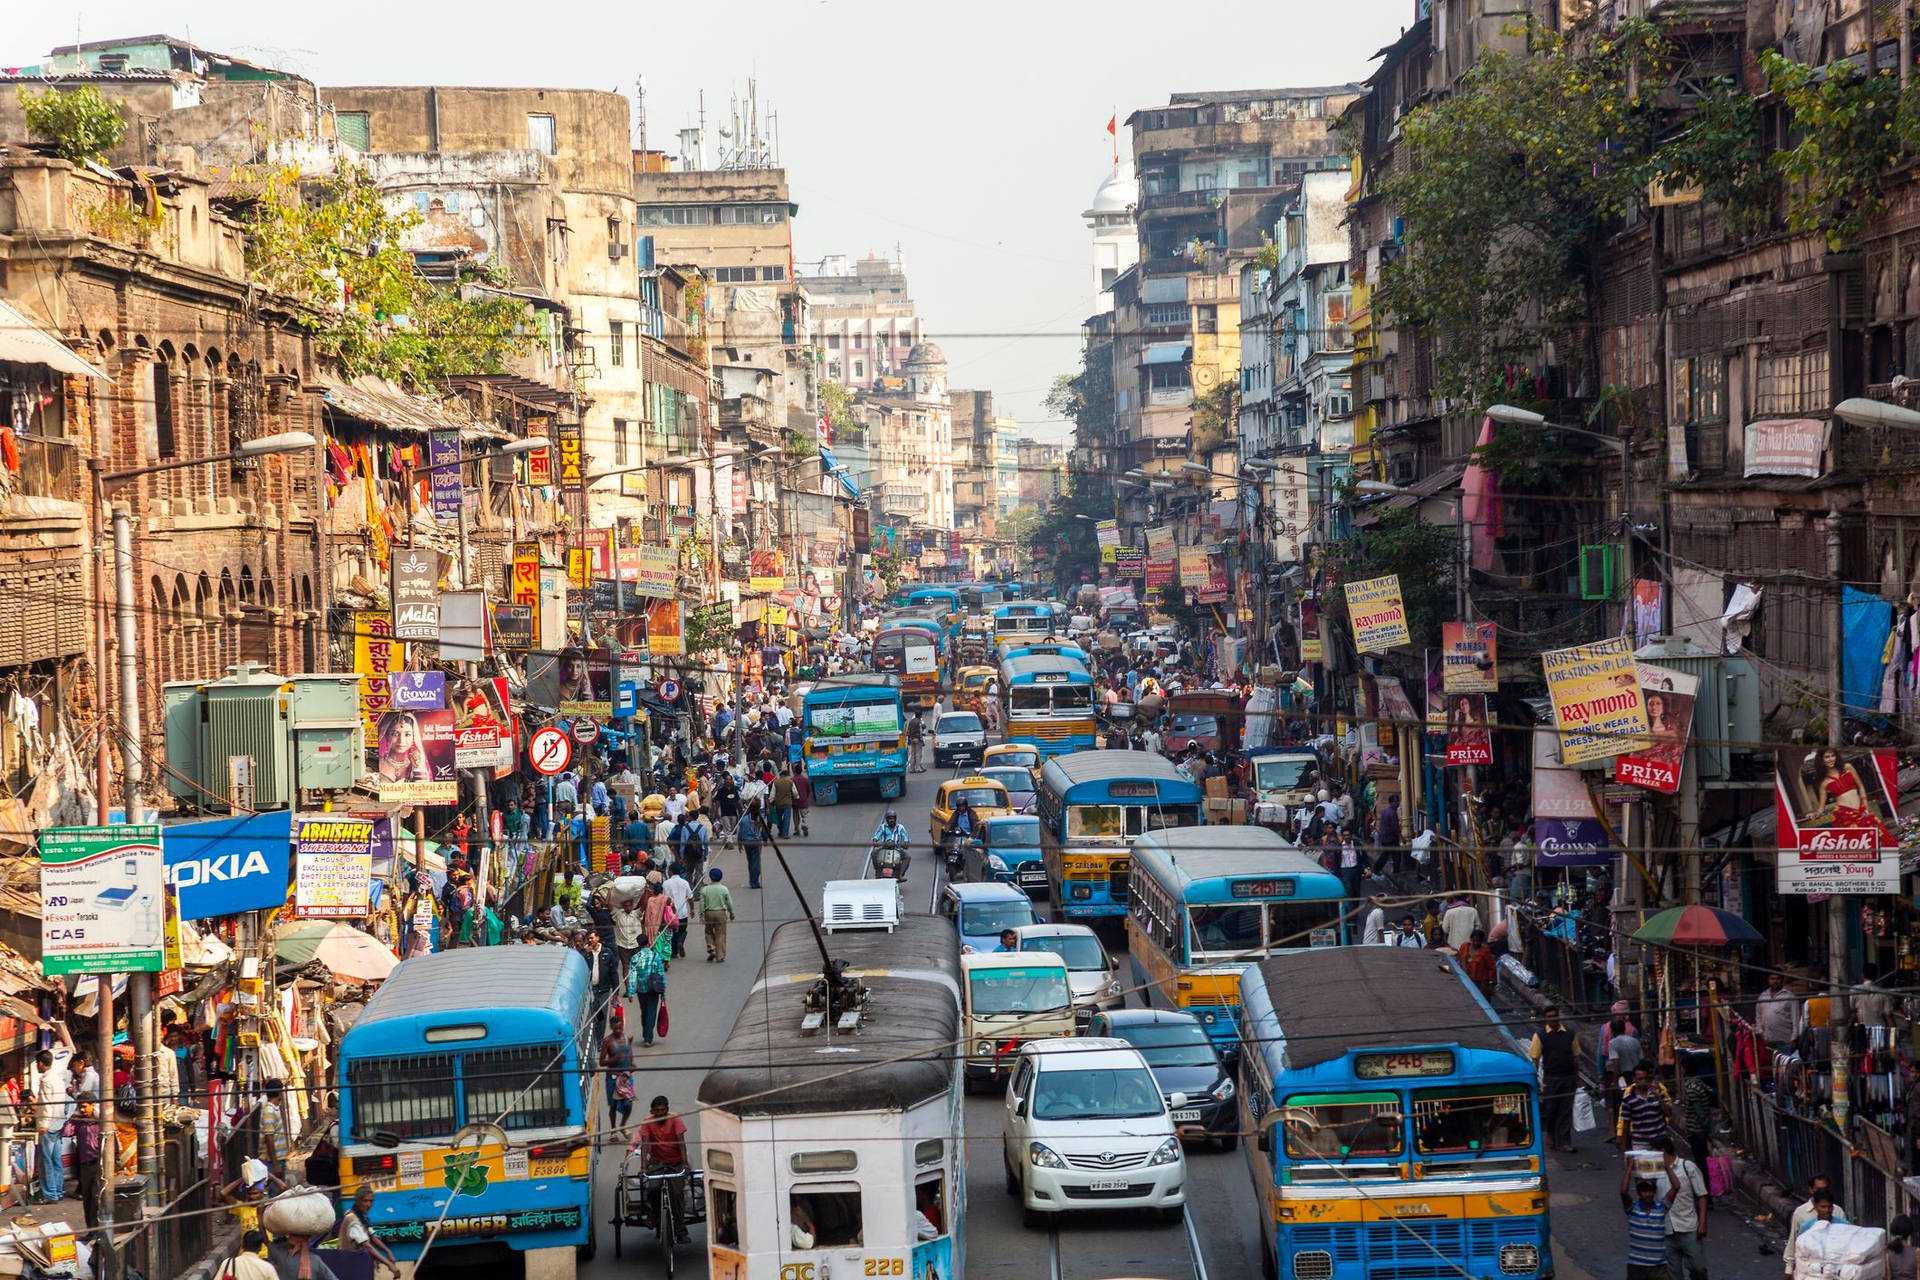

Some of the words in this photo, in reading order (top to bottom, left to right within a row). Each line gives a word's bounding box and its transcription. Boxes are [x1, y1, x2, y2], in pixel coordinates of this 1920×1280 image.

[1346, 583, 1371, 594] ROYAL
[1371, 576, 1398, 590] TOUCH
[399, 605, 437, 626] Mala
[1355, 607, 1402, 629] Raymond
[397, 628, 438, 638] SAREES
[1357, 635, 1376, 644] DRESS
[1376, 629, 1408, 639] MATERIALS
[1358, 628, 1380, 637] ETHNIC
[1381, 624, 1397, 632] WEAR
[1545, 647, 1585, 668] ROYAL
[1586, 637, 1629, 659] TOUCH
[1548, 661, 1600, 683] CREATIONS
[396, 686, 437, 703] CROWN
[1560, 688, 1638, 724] Raymond
[1567, 723, 1601, 737] ETHNIC
[1603, 717, 1630, 729] WEAR
[1632, 715, 1639, 724] &
[455, 728, 496, 746] Ashok
[1564, 735, 1594, 748] DRESS
[1596, 724, 1647, 741] MATERIALS
[1450, 746, 1489, 760] PRIYA
[1621, 762, 1675, 784] PRIYA
[379, 783, 407, 793] Madanji
[408, 782, 436, 793] Meghraj
[437, 782, 443, 790] &
[1632, 777, 1661, 788] SAREES
[300, 823, 372, 844] ABHISHEK
[1801, 830, 1872, 855] Ashok
[301, 843, 369, 853] SHERWANI
[1541, 837, 1597, 857] CROWN
[84, 856, 113, 868] Platinum
[114, 850, 137, 860] Jubilee
[1843, 864, 1874, 878] Young
[49, 896, 68, 907] AND
[50, 913, 75, 922] Essae
[77, 912, 99, 921] Teraoka
[51, 929, 85, 940] CAS
[1386, 1054, 1423, 1069] 24B
[1394, 1203, 1432, 1215] TATA
[781, 1262, 815, 1280] CTC
[864, 1258, 904, 1276] 228
